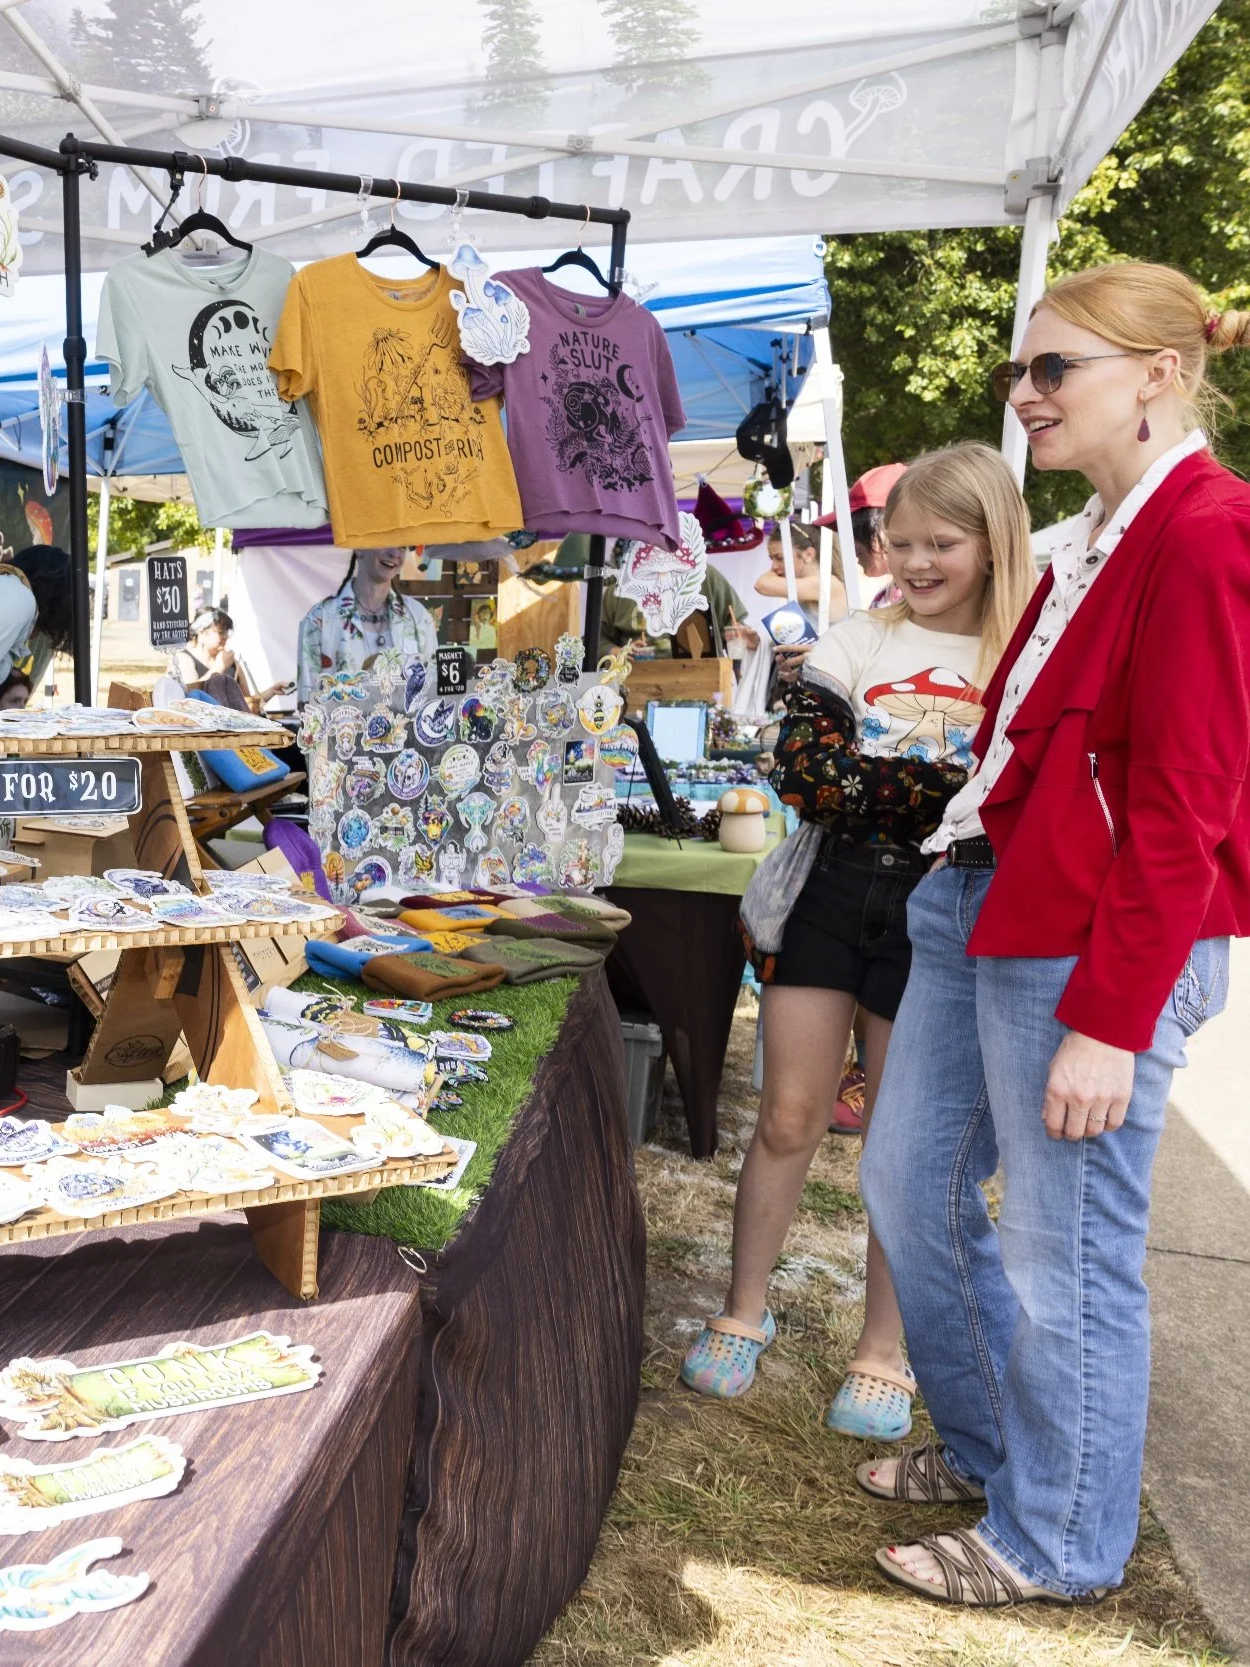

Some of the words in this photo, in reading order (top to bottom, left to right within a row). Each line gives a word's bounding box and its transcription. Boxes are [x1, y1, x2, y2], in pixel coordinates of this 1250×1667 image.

[209, 345, 243, 358] MAKE
[558, 330, 620, 361] NATURE
[570, 347, 614, 374] SLUT
[257, 388, 277, 399] THE
[372, 437, 442, 469] COMPOST
[153, 560, 183, 580] HATS
[156, 585, 181, 614] $30
[172, 629, 189, 639] ARTIST
[438, 651, 464, 661] MAGNET
[441, 662, 460, 684] $6
[1, 771, 57, 803] FOR
[68, 770, 117, 801] $20
[103, 1348, 247, 1390] CONK
[150, 1378, 195, 1395] YOU
[202, 1365, 256, 1384] LOVE
[130, 1376, 273, 1413] MUSHROOMS
